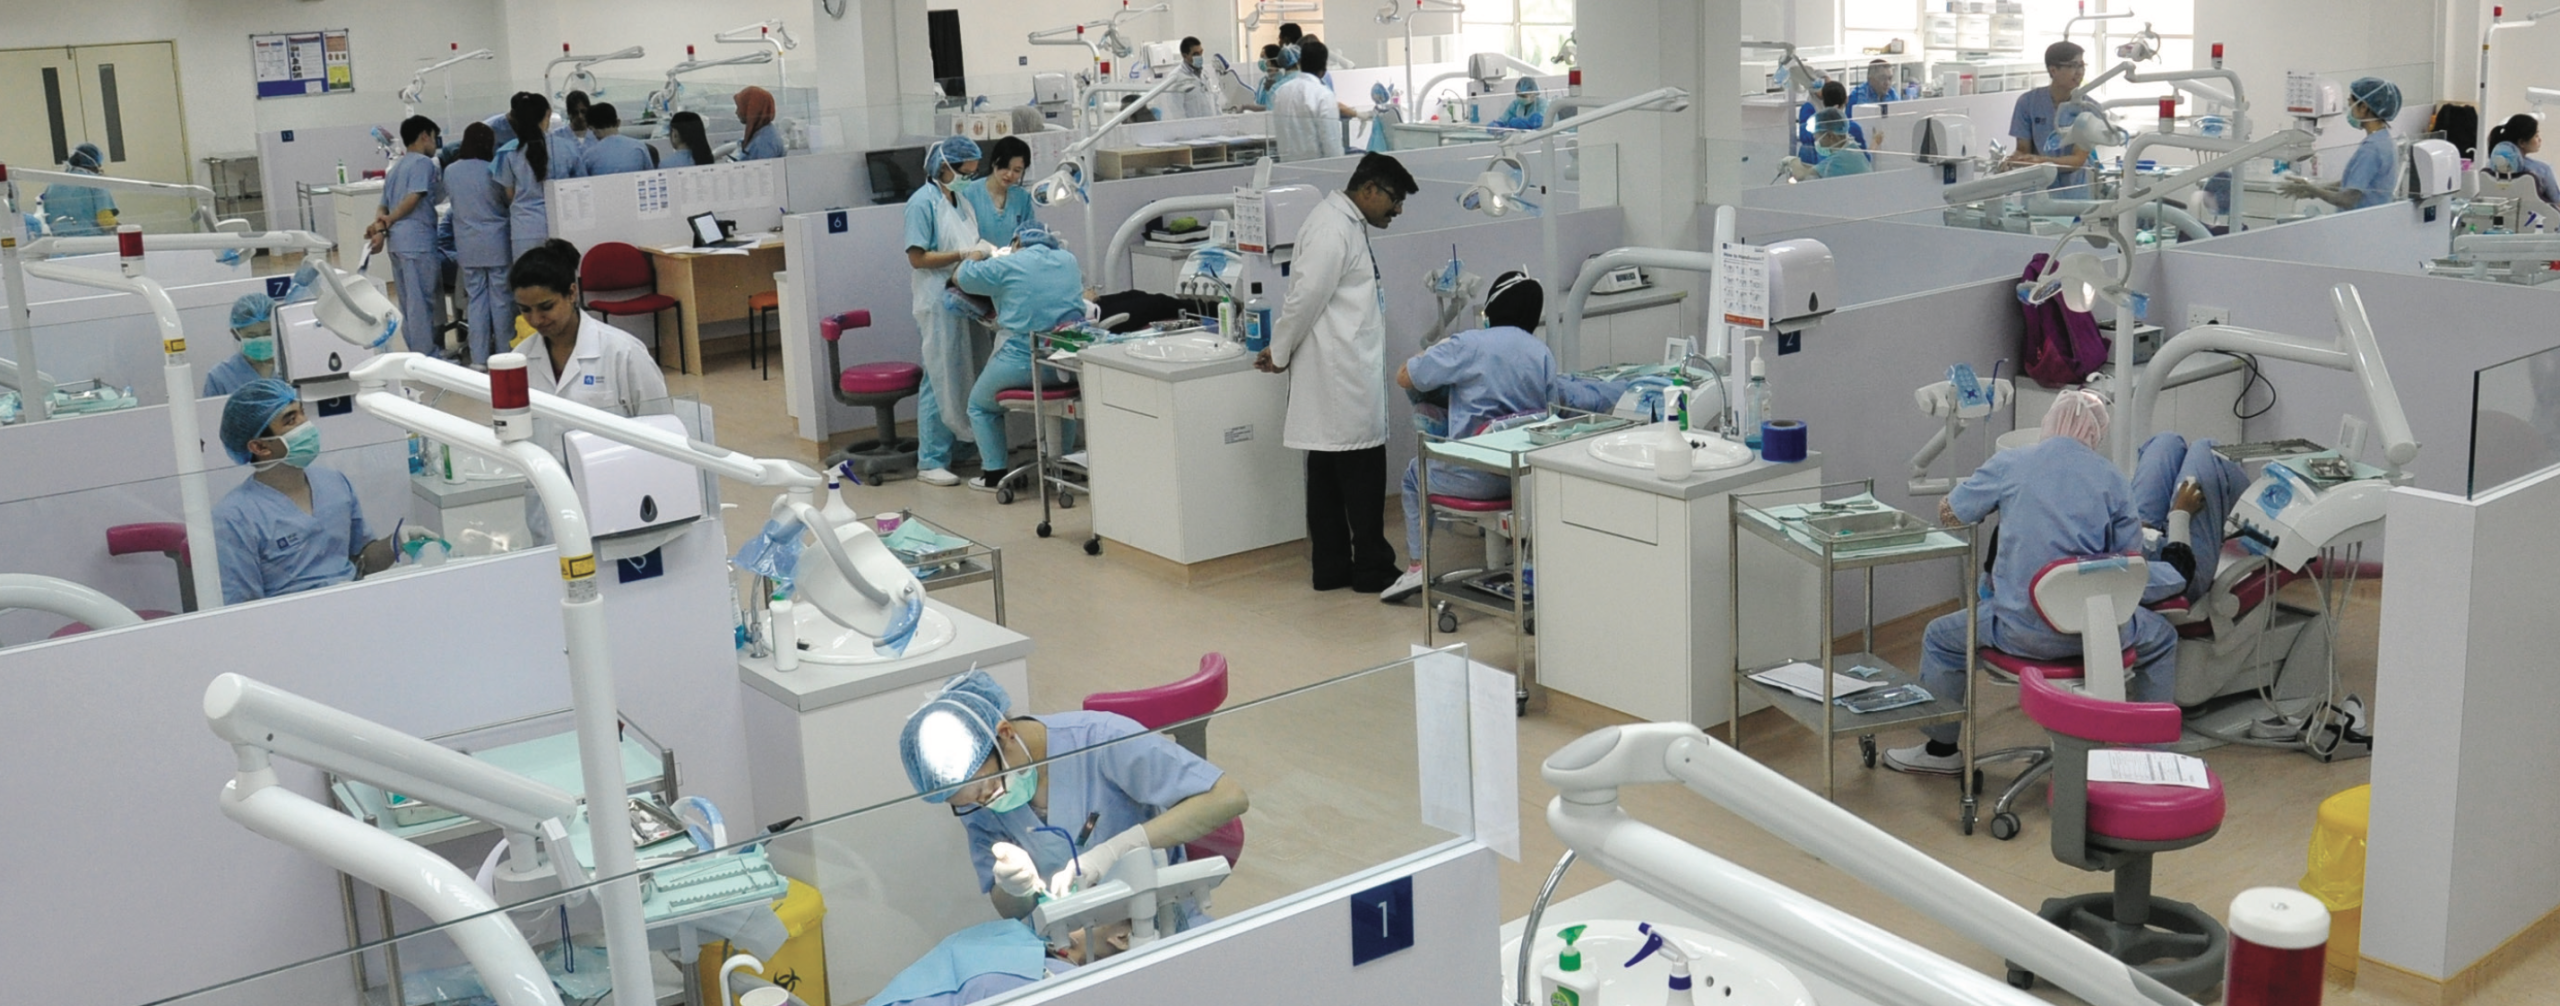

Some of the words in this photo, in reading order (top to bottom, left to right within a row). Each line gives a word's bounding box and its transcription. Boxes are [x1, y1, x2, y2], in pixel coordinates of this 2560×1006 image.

[833, 216, 842, 228] 6
[273, 281, 284, 295] 7
[1377, 901, 1388, 938] 1
